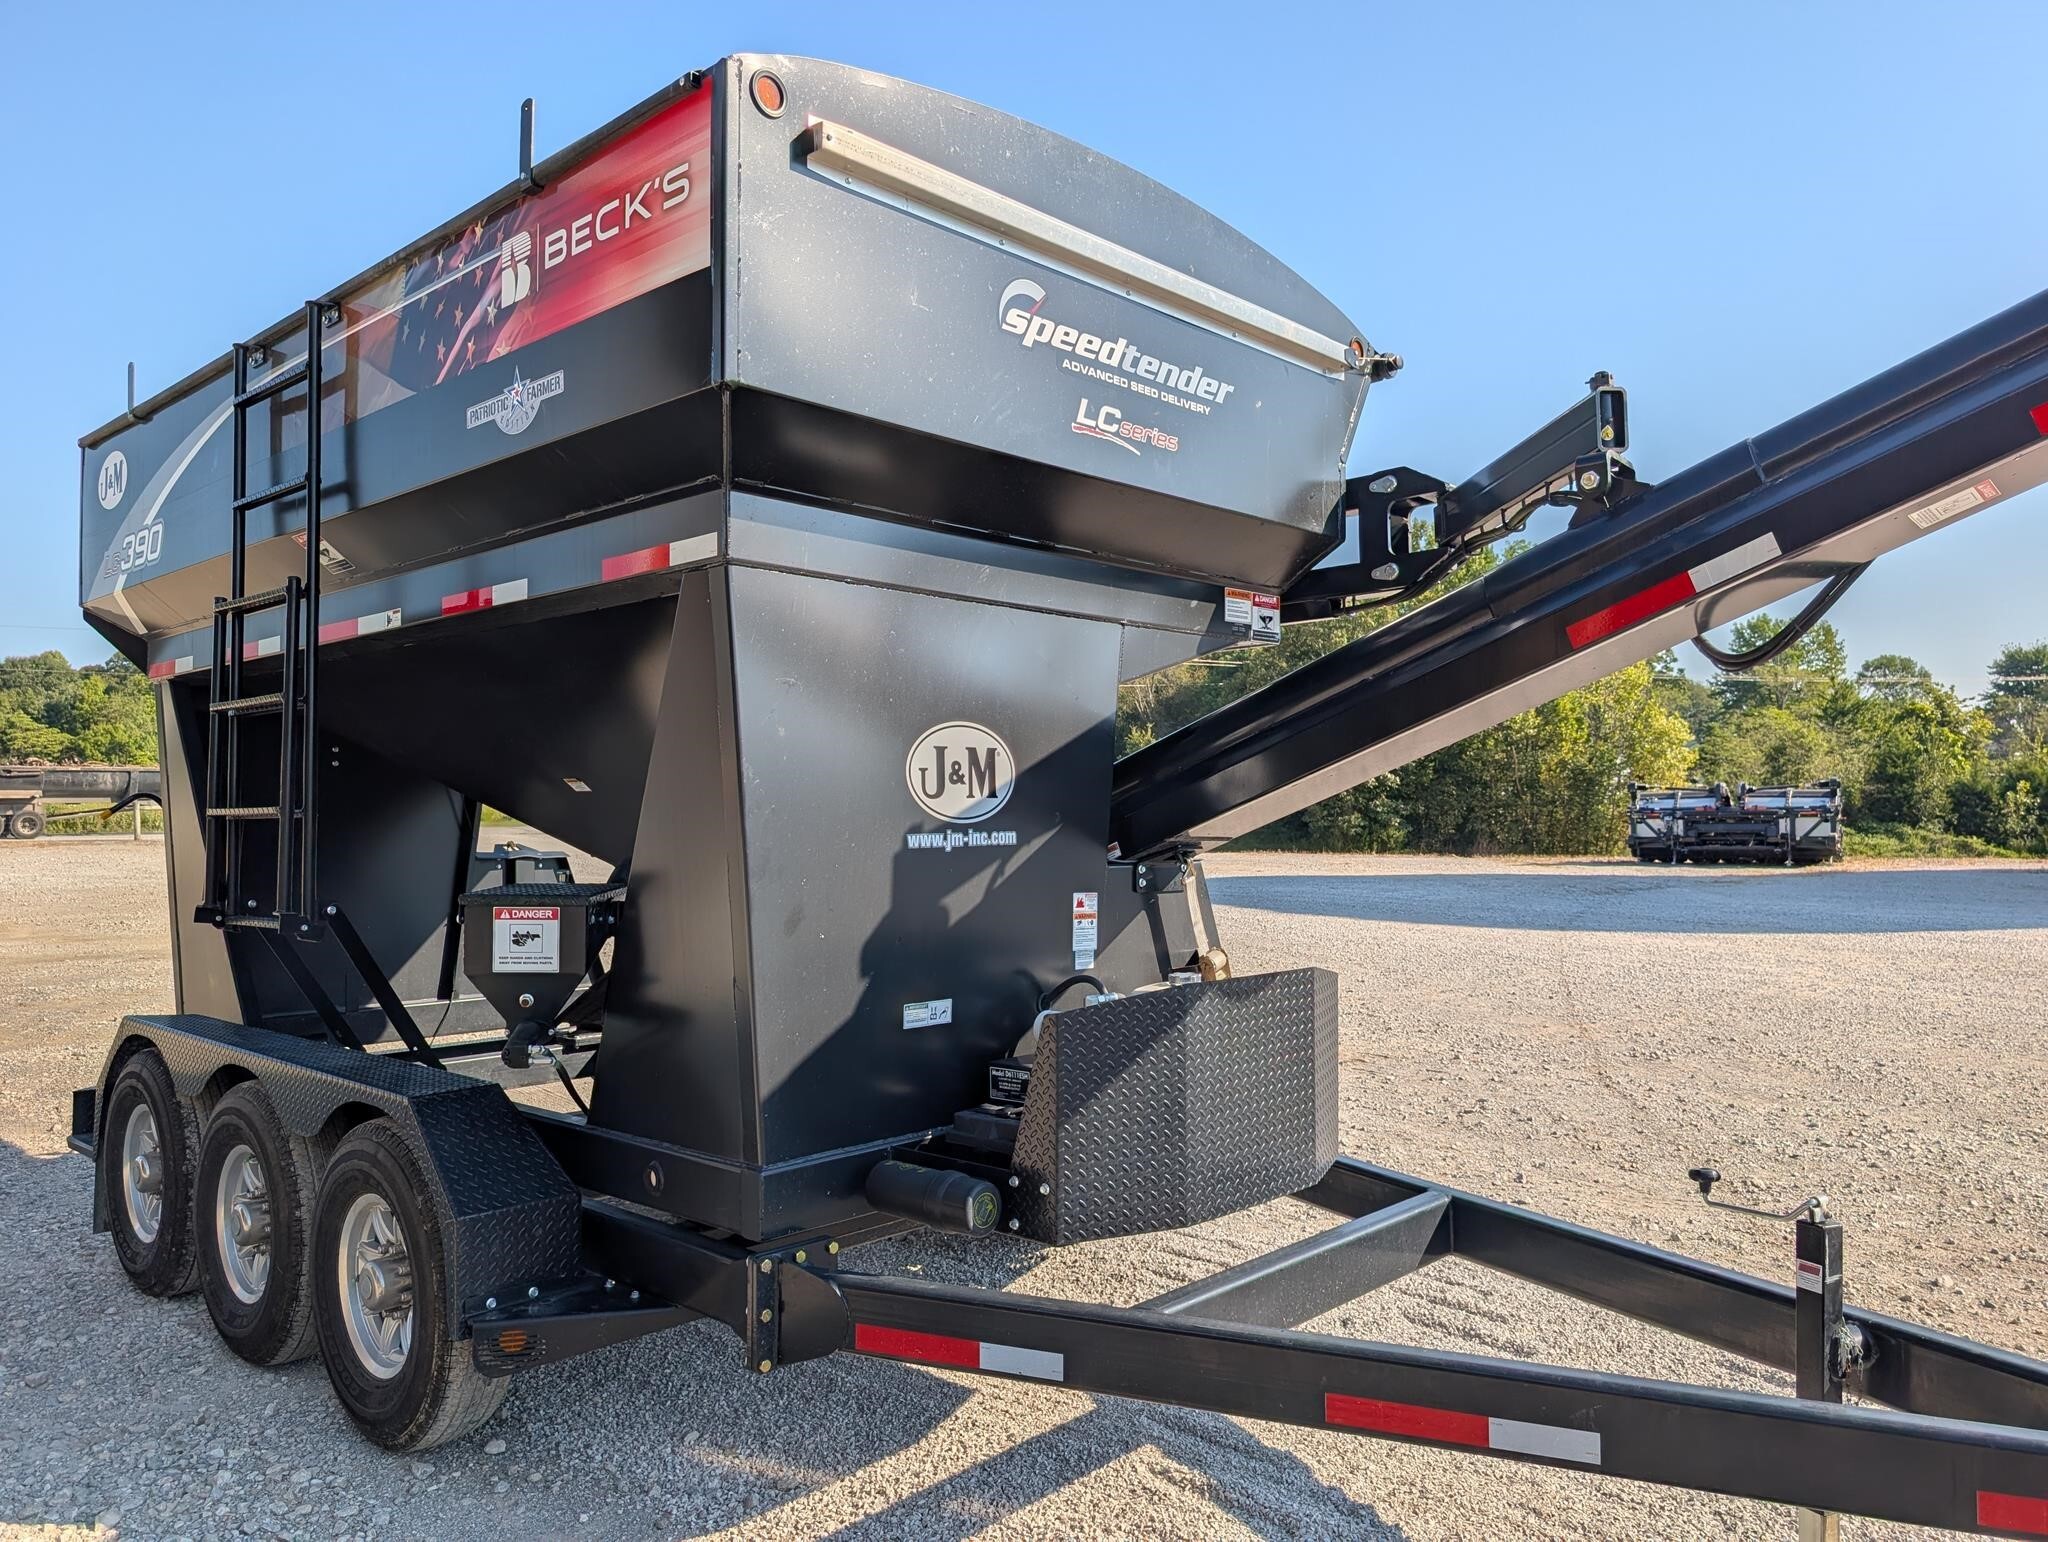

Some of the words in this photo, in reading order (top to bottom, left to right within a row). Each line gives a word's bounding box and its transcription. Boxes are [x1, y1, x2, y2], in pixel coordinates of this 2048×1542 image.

[544, 162, 690, 270] BECK'S
[469, 396, 510, 425] PATRIOTIC
[526, 375, 561, 402] FARMER
[1062, 358, 1129, 389] ADVANCED
[1130, 380, 1159, 399] SEED
[1160, 391, 1211, 416] DELIVERY
[1076, 398, 1122, 433] LC
[1119, 421, 1179, 451] series
[101, 459, 124, 501] J&M
[1259, 595, 1277, 604] DANGER
[918, 745, 999, 800] J&M
[906, 828, 1018, 853] www.jm-inc.com
[512, 910, 553, 919] DANGER
